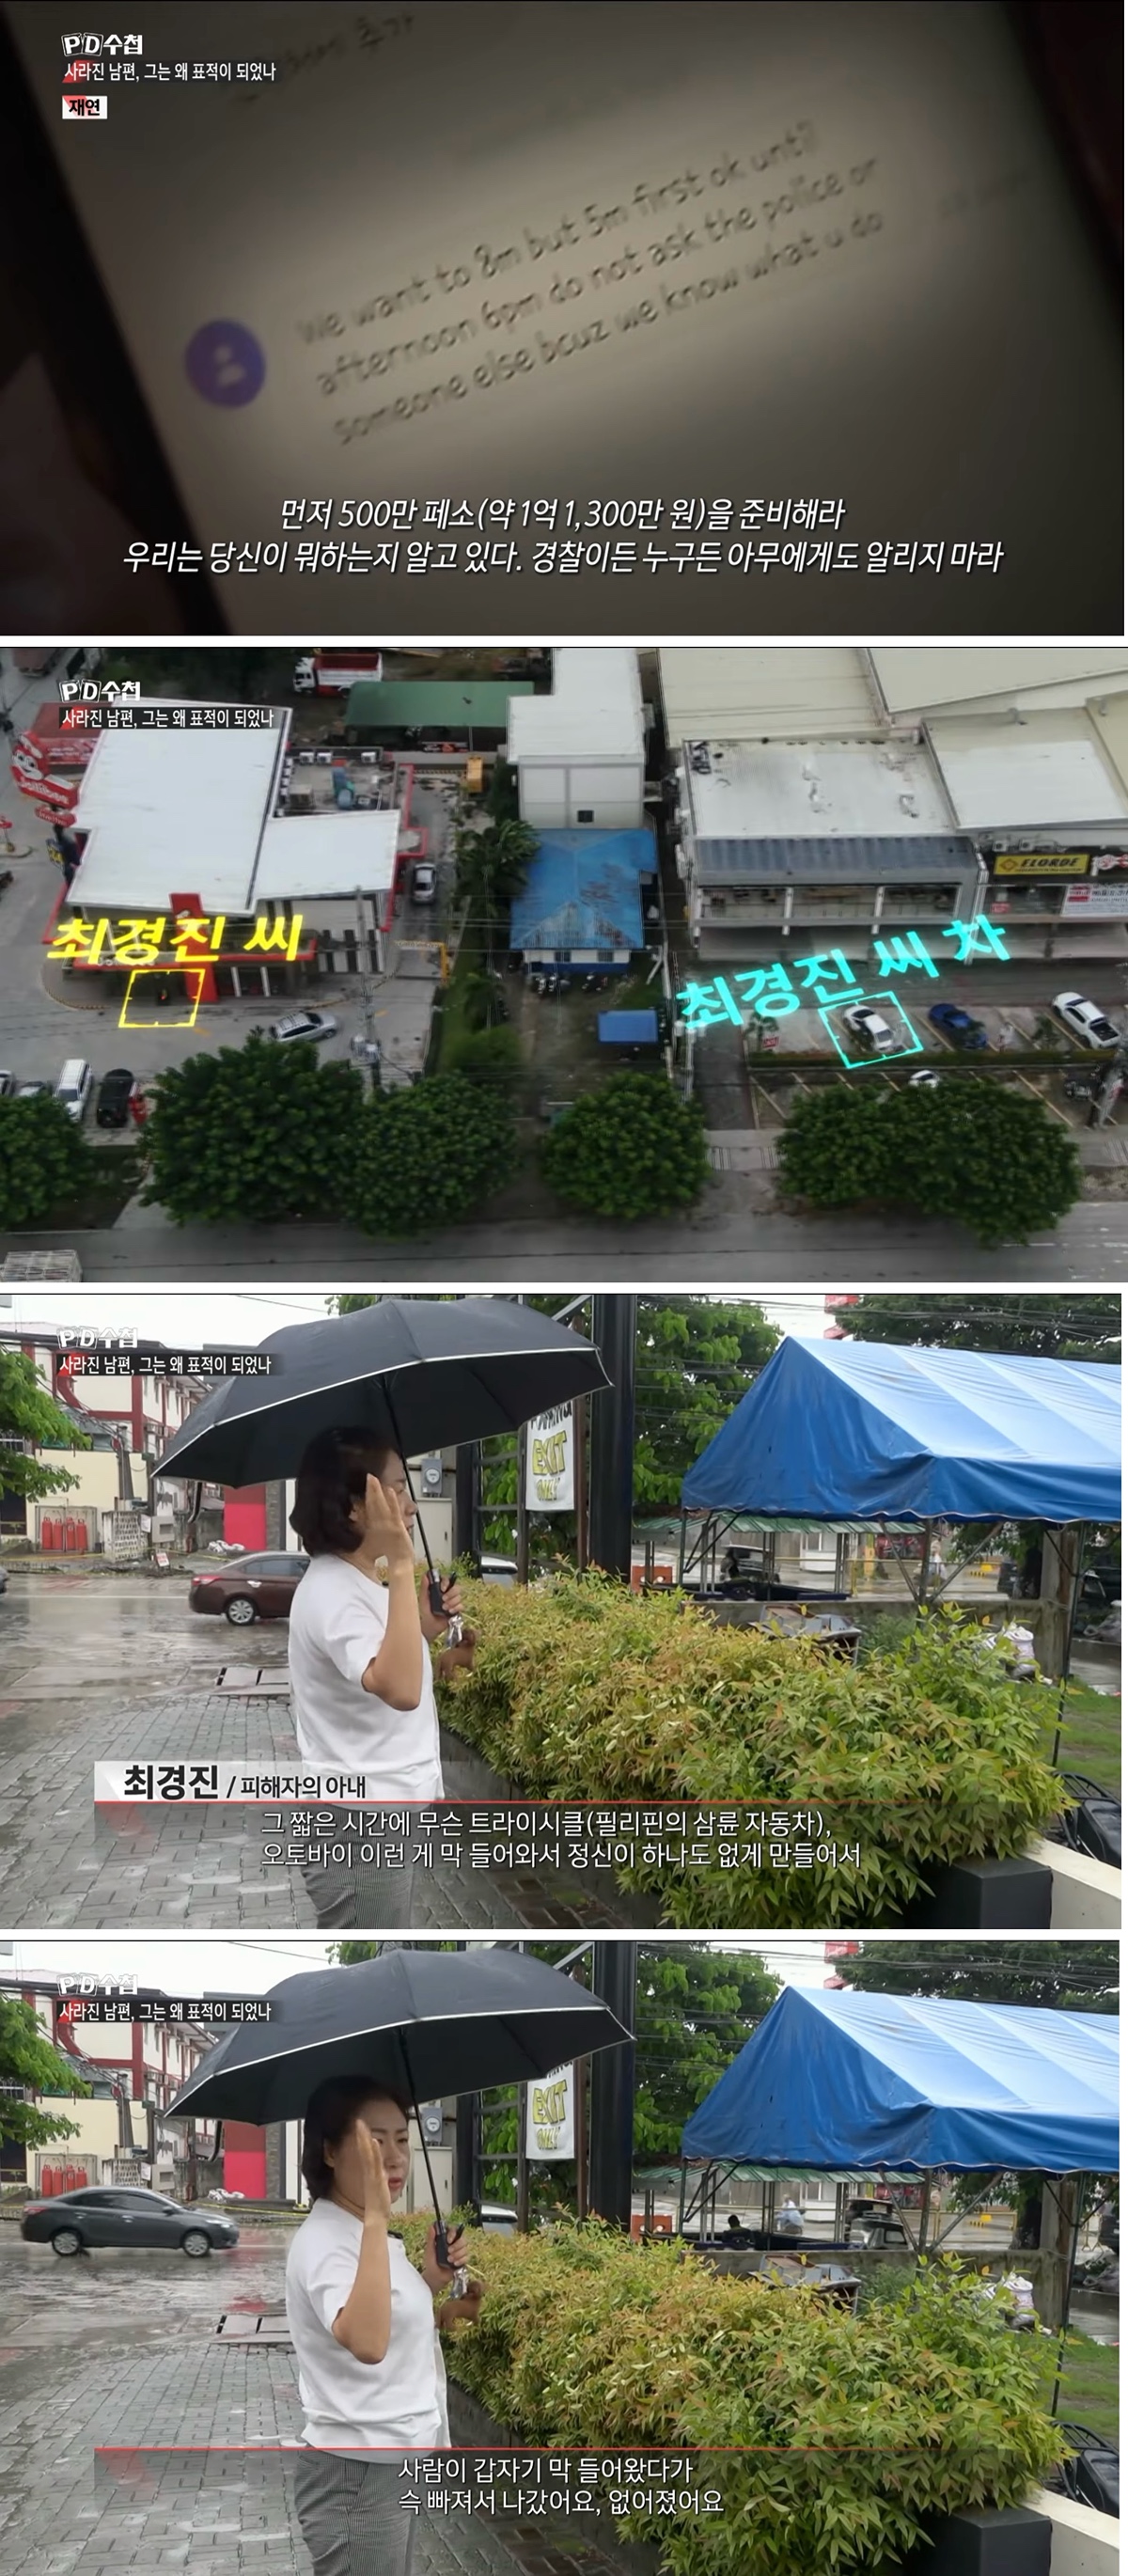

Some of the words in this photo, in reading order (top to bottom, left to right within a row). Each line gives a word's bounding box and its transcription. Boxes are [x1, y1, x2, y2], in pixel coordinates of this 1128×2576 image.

[316, 319, 476, 396] afternoon
[481, 292, 542, 334] 6pm
[549, 271, 584, 304] do
[591, 244, 643, 291] not
[647, 222, 703, 266] ask
[705, 207, 758, 243] the
[761, 173, 843, 230] police
[850, 156, 878, 186] or
[352, 273, 431, 325] want
[435, 262, 471, 294] to
[474, 243, 521, 278] 8m
[524, 217, 580, 260] but
[584, 203, 628, 237] 5m
[632, 167, 704, 216] first
[710, 151, 746, 187] ok
[333, 374, 468, 446] someone
[473, 348, 535, 388] else
[535, 320, 609, 364] bcuz
[615, 299, 658, 332] we
[660, 268, 739, 315] know
[746, 230, 820, 279] what
[824, 232, 843, 249] u
[852, 208, 883, 237] do
[532, 1430, 568, 1476] EXIT
[532, 2080, 568, 2125] EXIT
